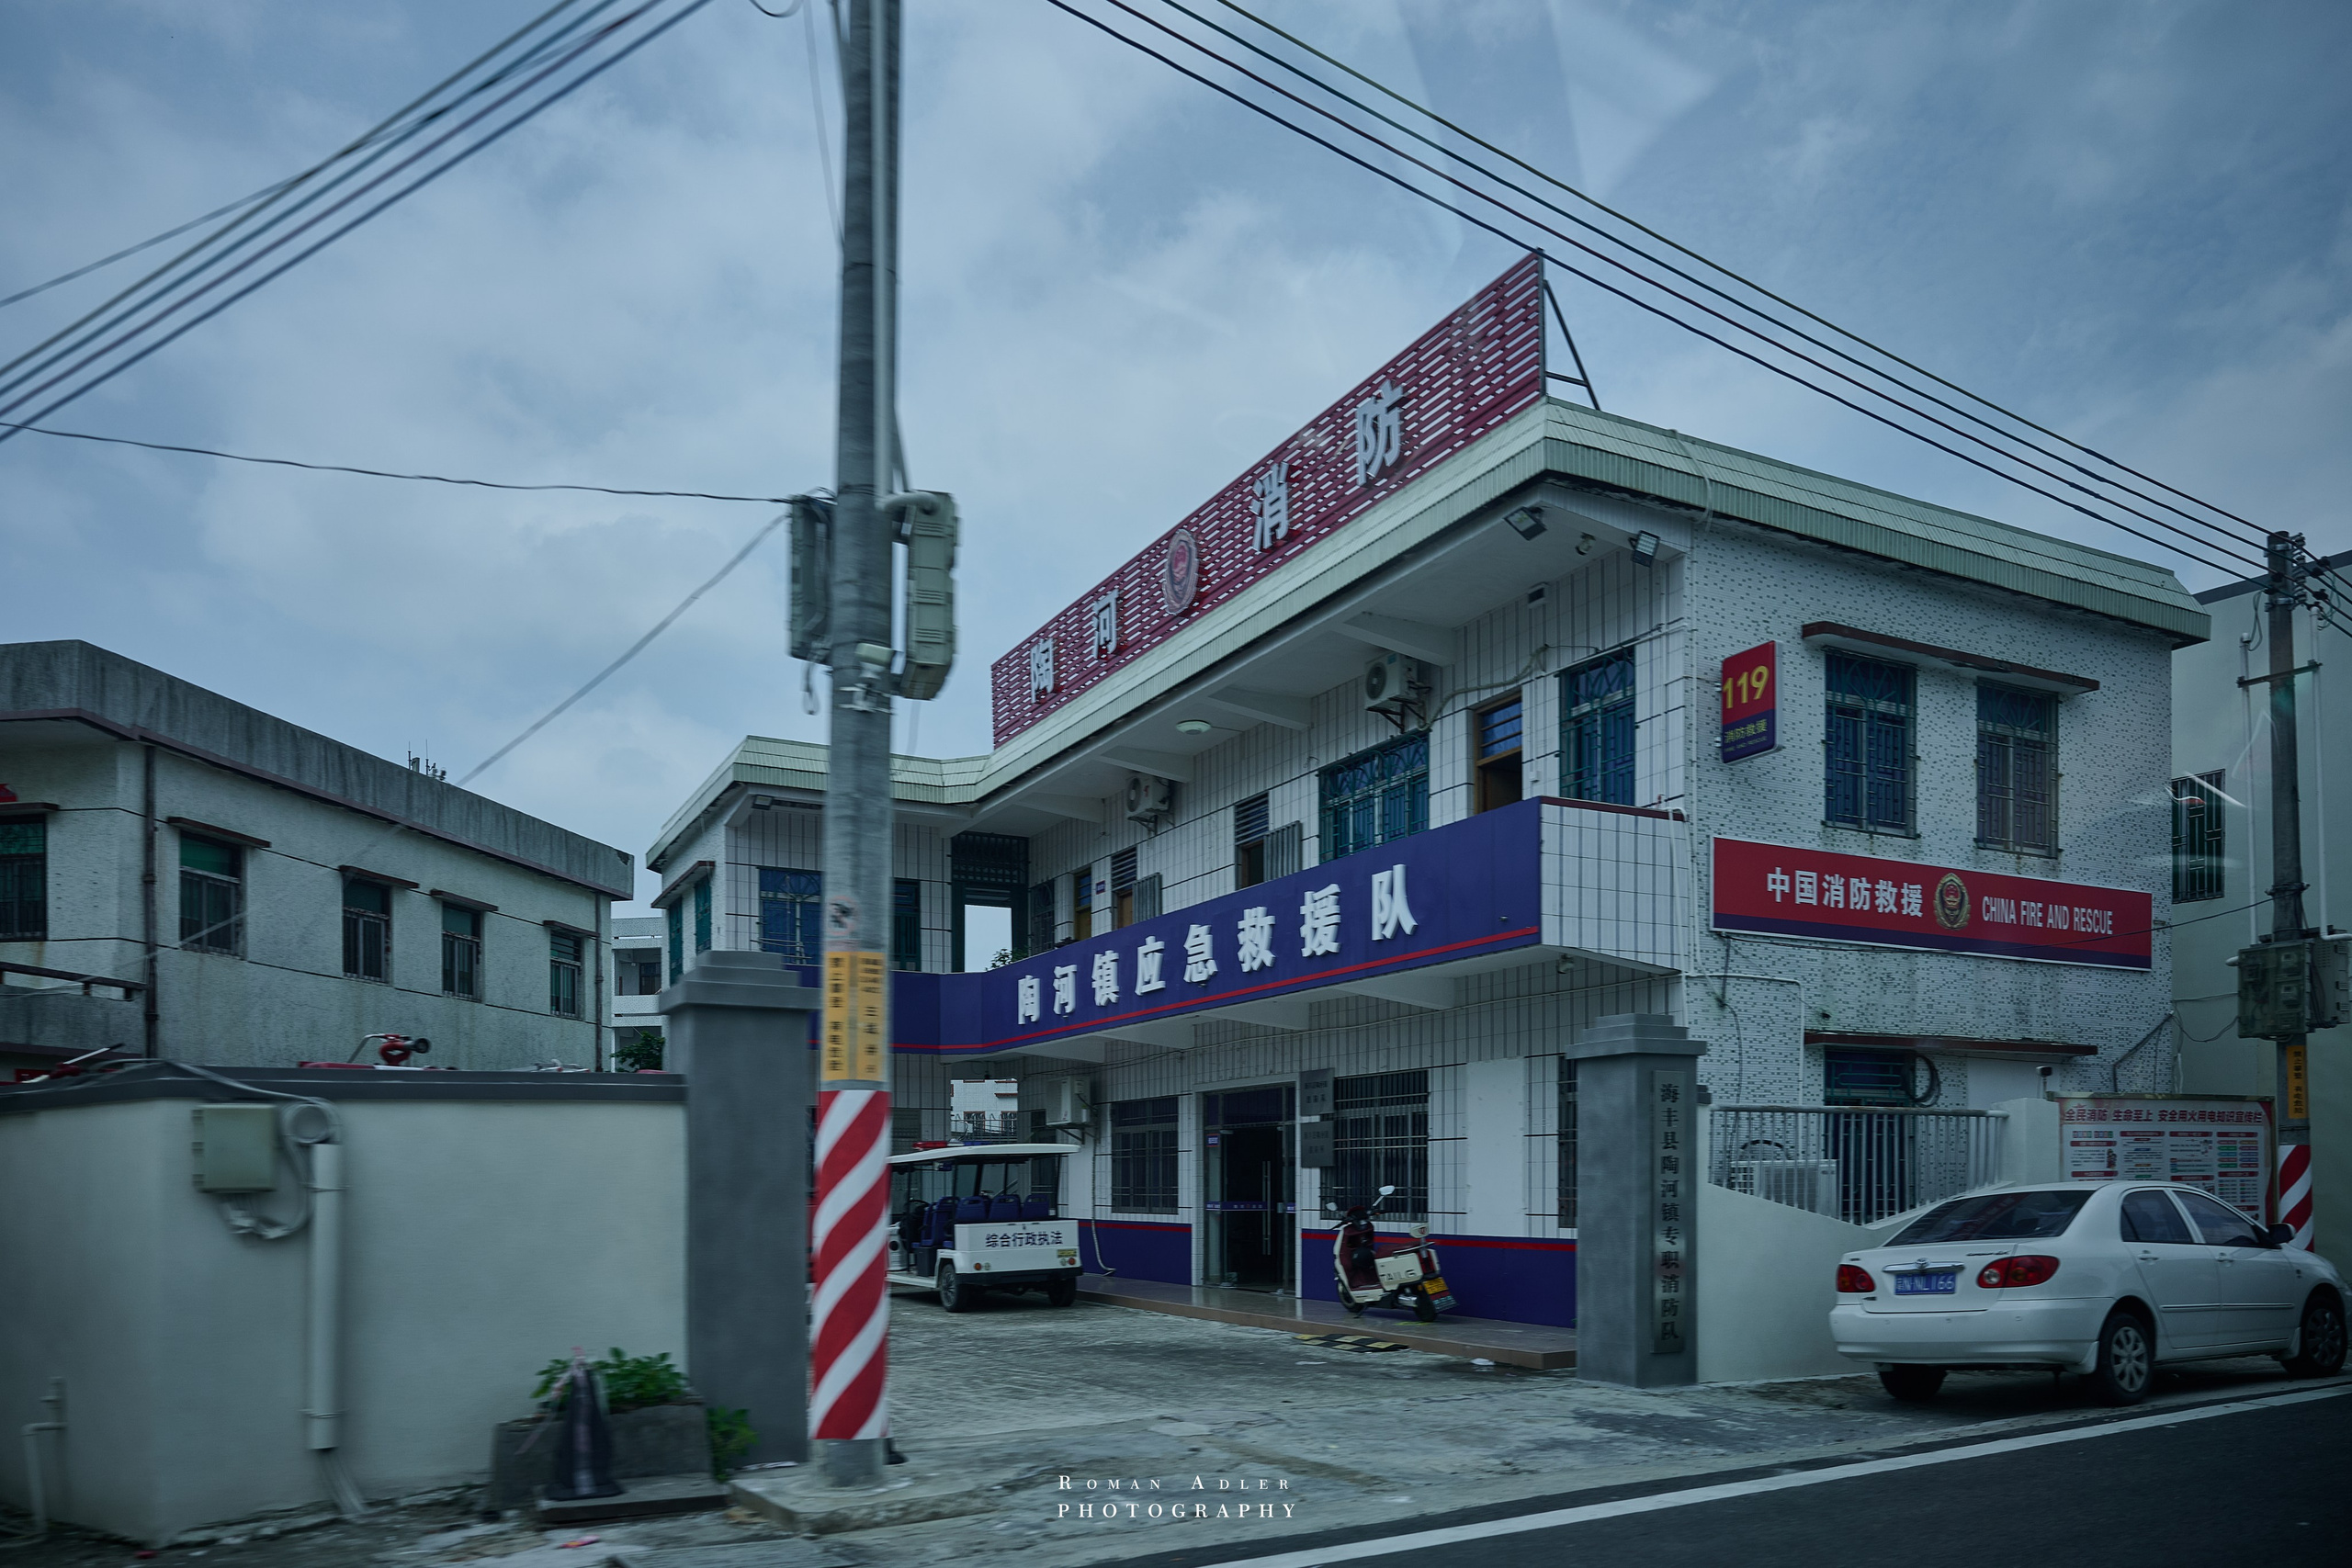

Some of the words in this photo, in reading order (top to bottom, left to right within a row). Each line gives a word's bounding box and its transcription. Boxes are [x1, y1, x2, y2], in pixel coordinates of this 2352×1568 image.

[1250, 378, 1406, 552] 消防
[1723, 665, 1770, 709] 119
[1724, 718, 1769, 744] 消防救援
[1766, 867, 1924, 919] 中国消防救援
[1981, 896, 2017, 926] CHINA
[2019, 899, 2043, 929] FIRE
[2047, 905, 2070, 931] AND
[2074, 908, 2113, 936] RESCUE
[2064, 1108, 2108, 1122] 全民消防
[2112, 1109, 2153, 1122] 生命至上
[2157, 1109, 2263, 1124] 安全用火用电知识宣传栏
[1660, 1082, 1680, 1341] 海丰县陶河镇专职消防队
[985, 1230, 1063, 1248] 综合行政执法
